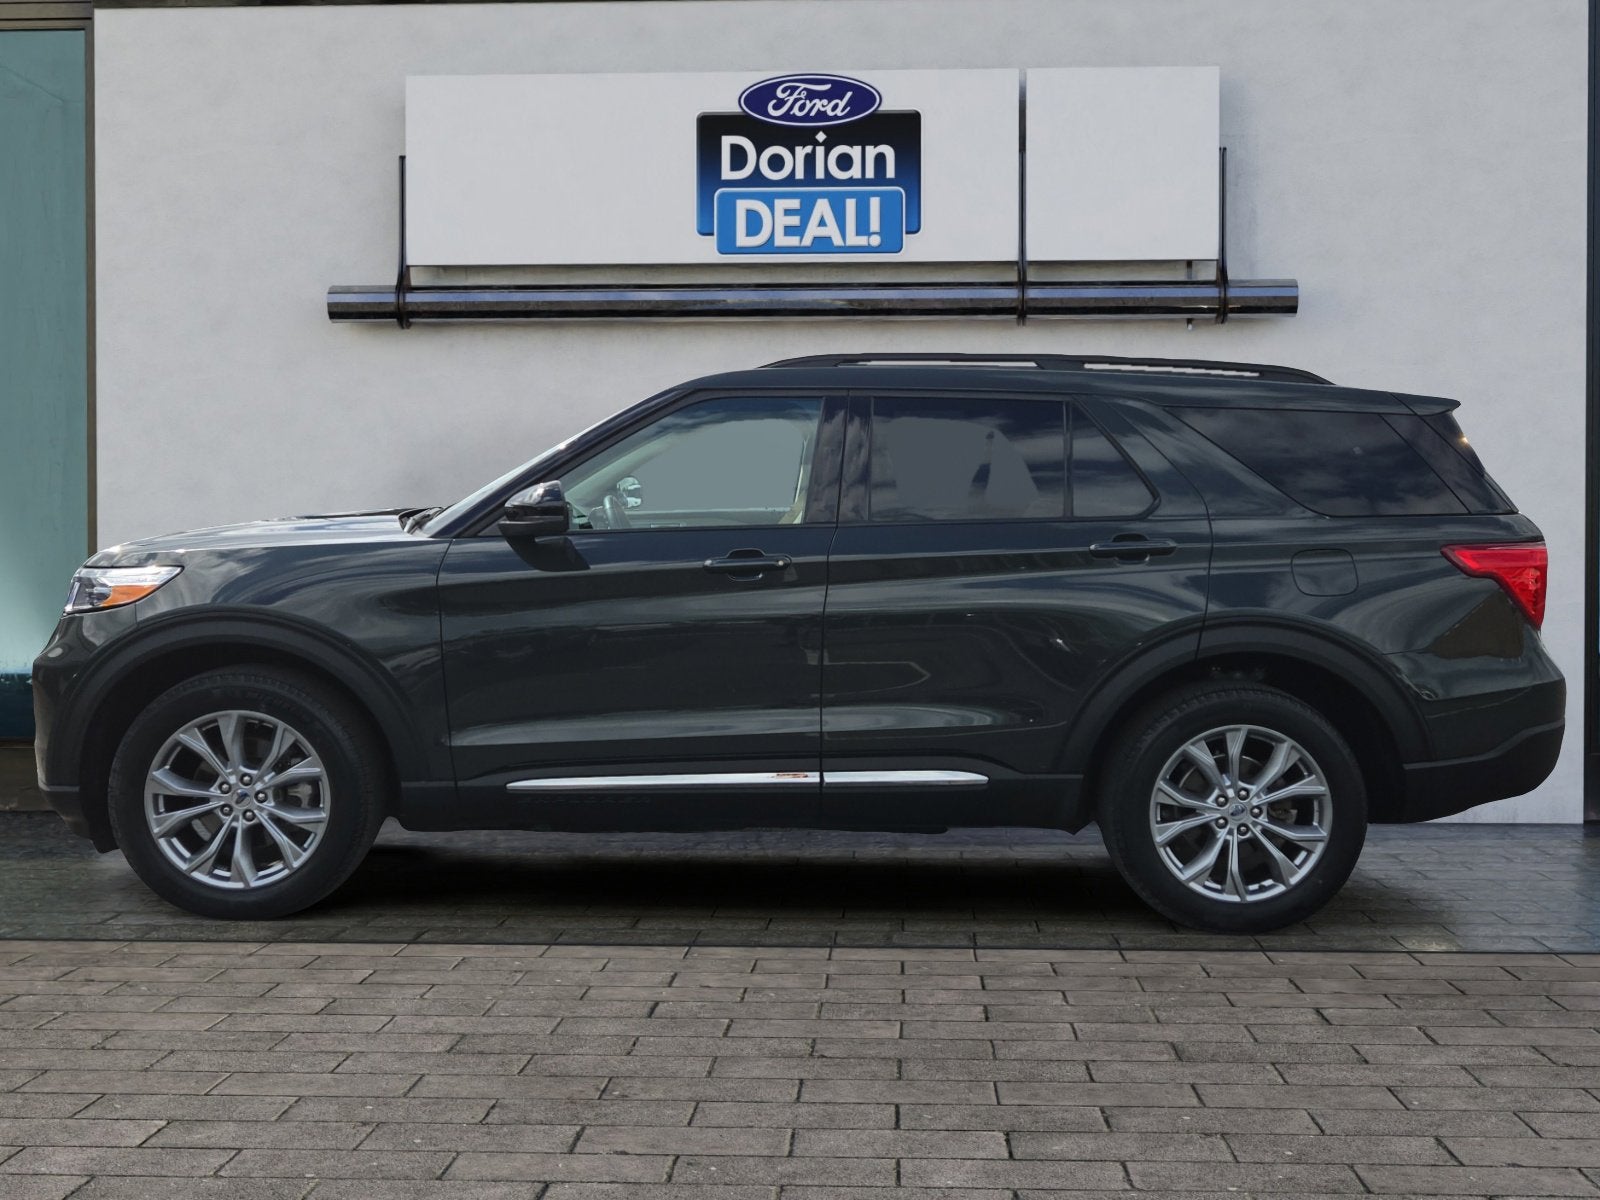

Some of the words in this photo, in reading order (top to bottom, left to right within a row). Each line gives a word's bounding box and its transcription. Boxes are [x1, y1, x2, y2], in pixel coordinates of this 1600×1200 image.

[767, 82, 853, 117] Ford
[721, 131, 895, 181] Dorian
[735, 197, 882, 248] DEAL!
